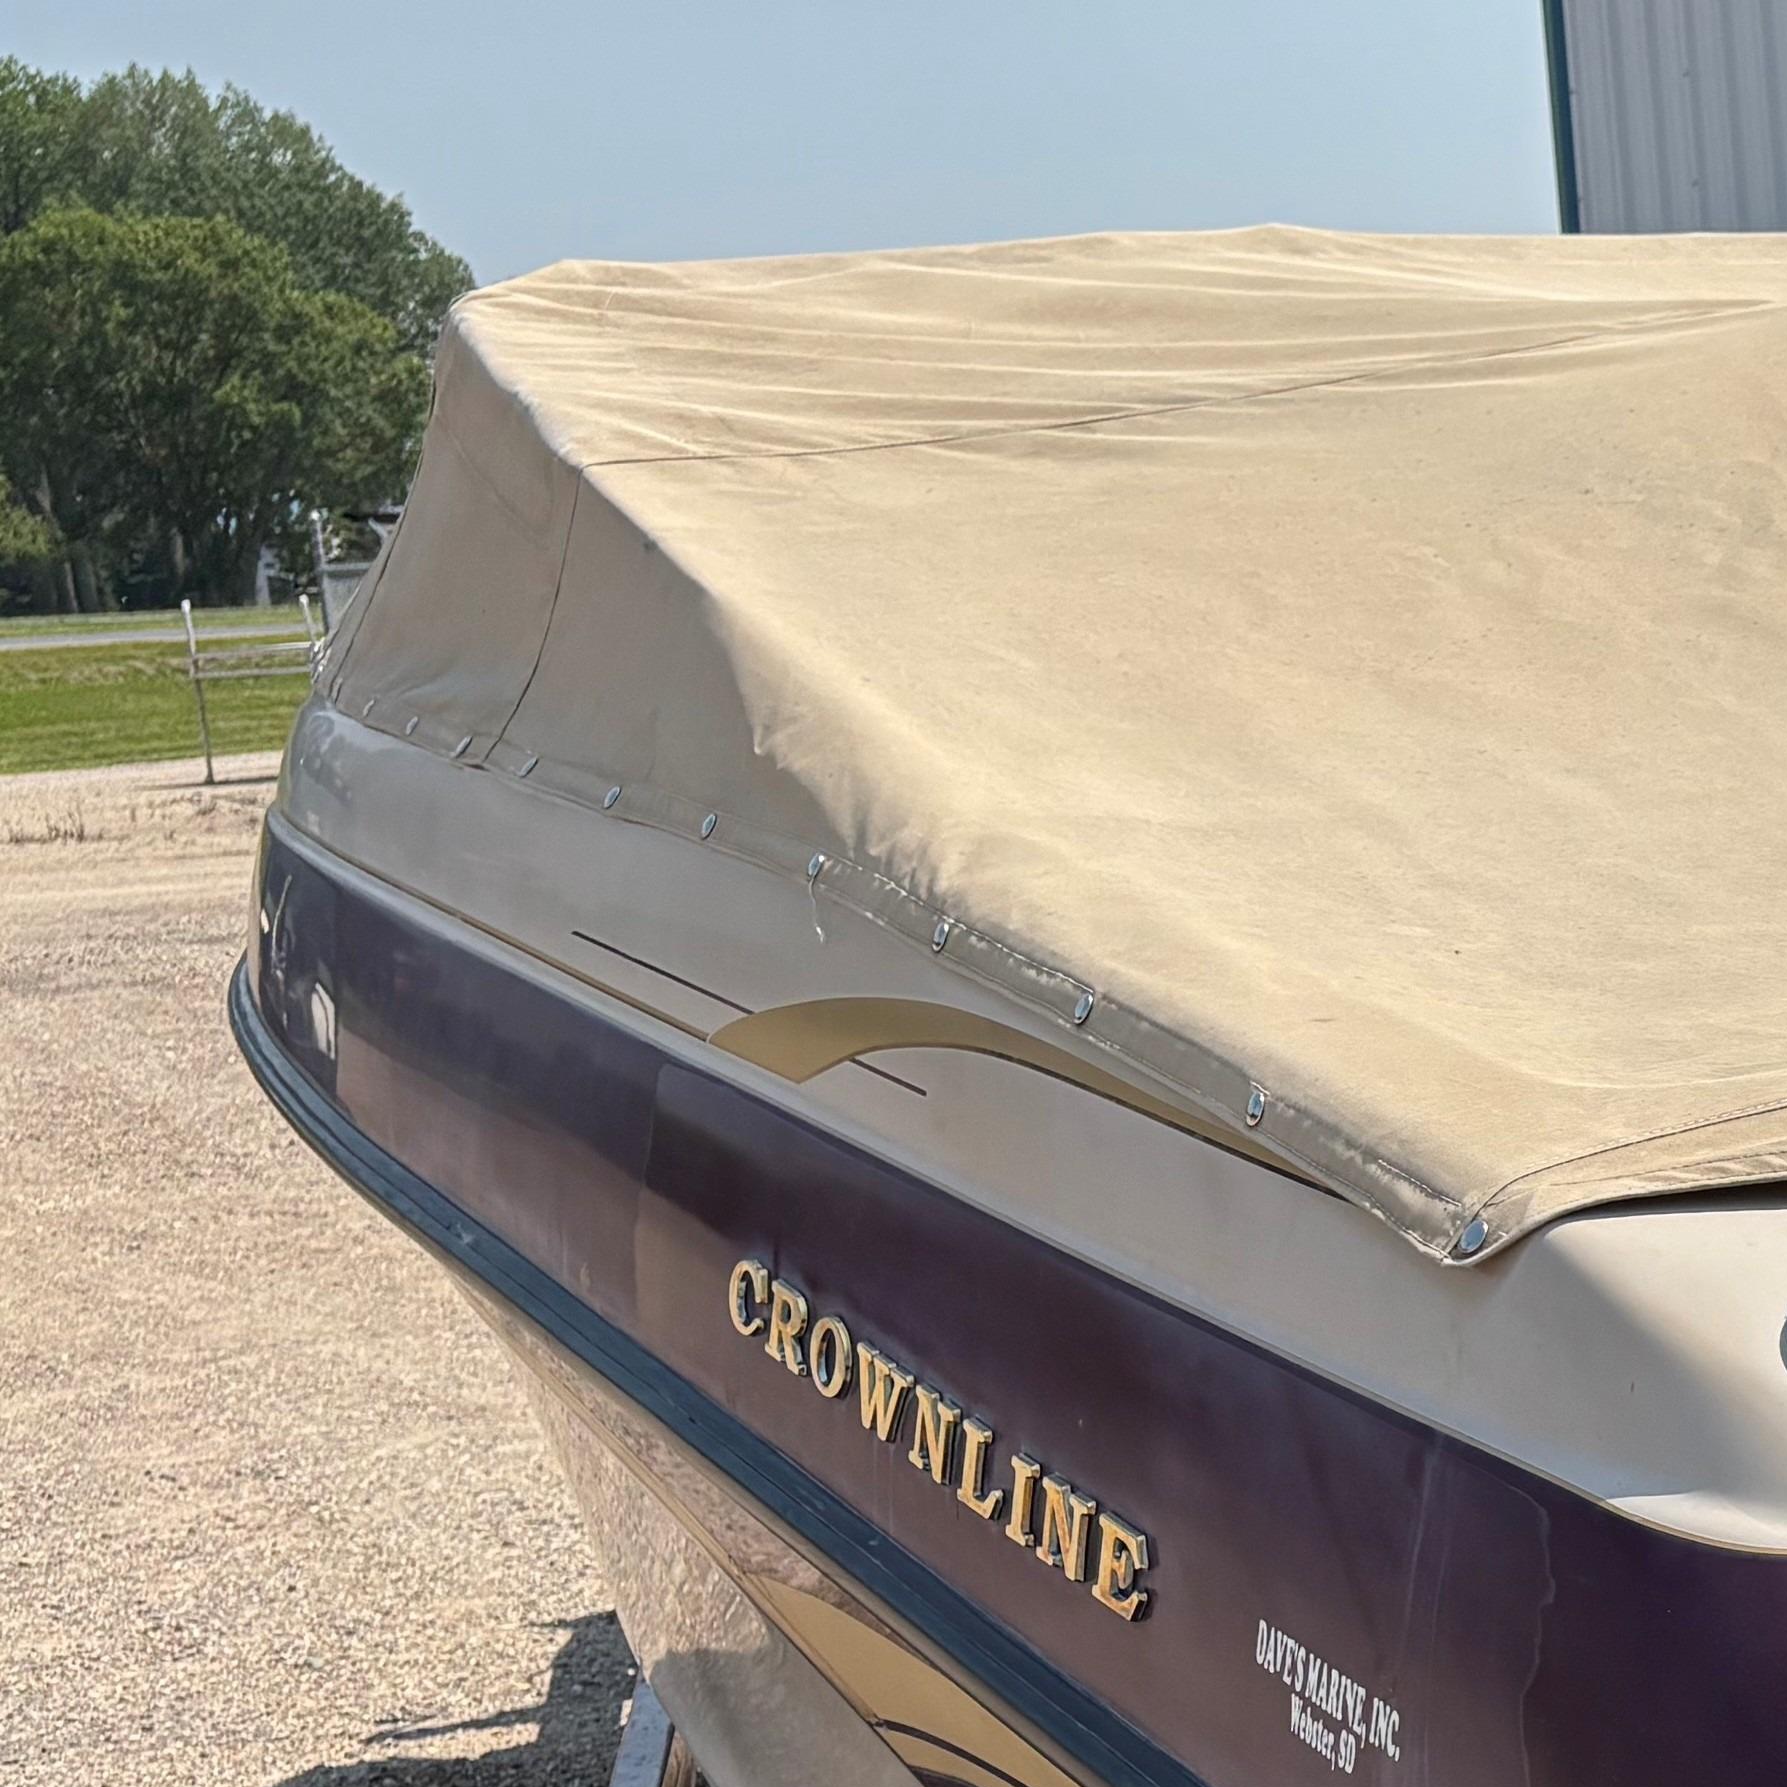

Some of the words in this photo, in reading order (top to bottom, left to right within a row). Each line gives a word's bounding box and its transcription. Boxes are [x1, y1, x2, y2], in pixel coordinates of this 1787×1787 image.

[727, 1257, 1150, 1623] CROWNLINE
[1255, 1618, 1306, 1693] DAVE'S
[1304, 1652, 1367, 1749] MARINE,
[1368, 1696, 1400, 1762] INC.
[1290, 1692, 1336, 1771] Webster,
[1337, 1729, 1357, 1775] SD
